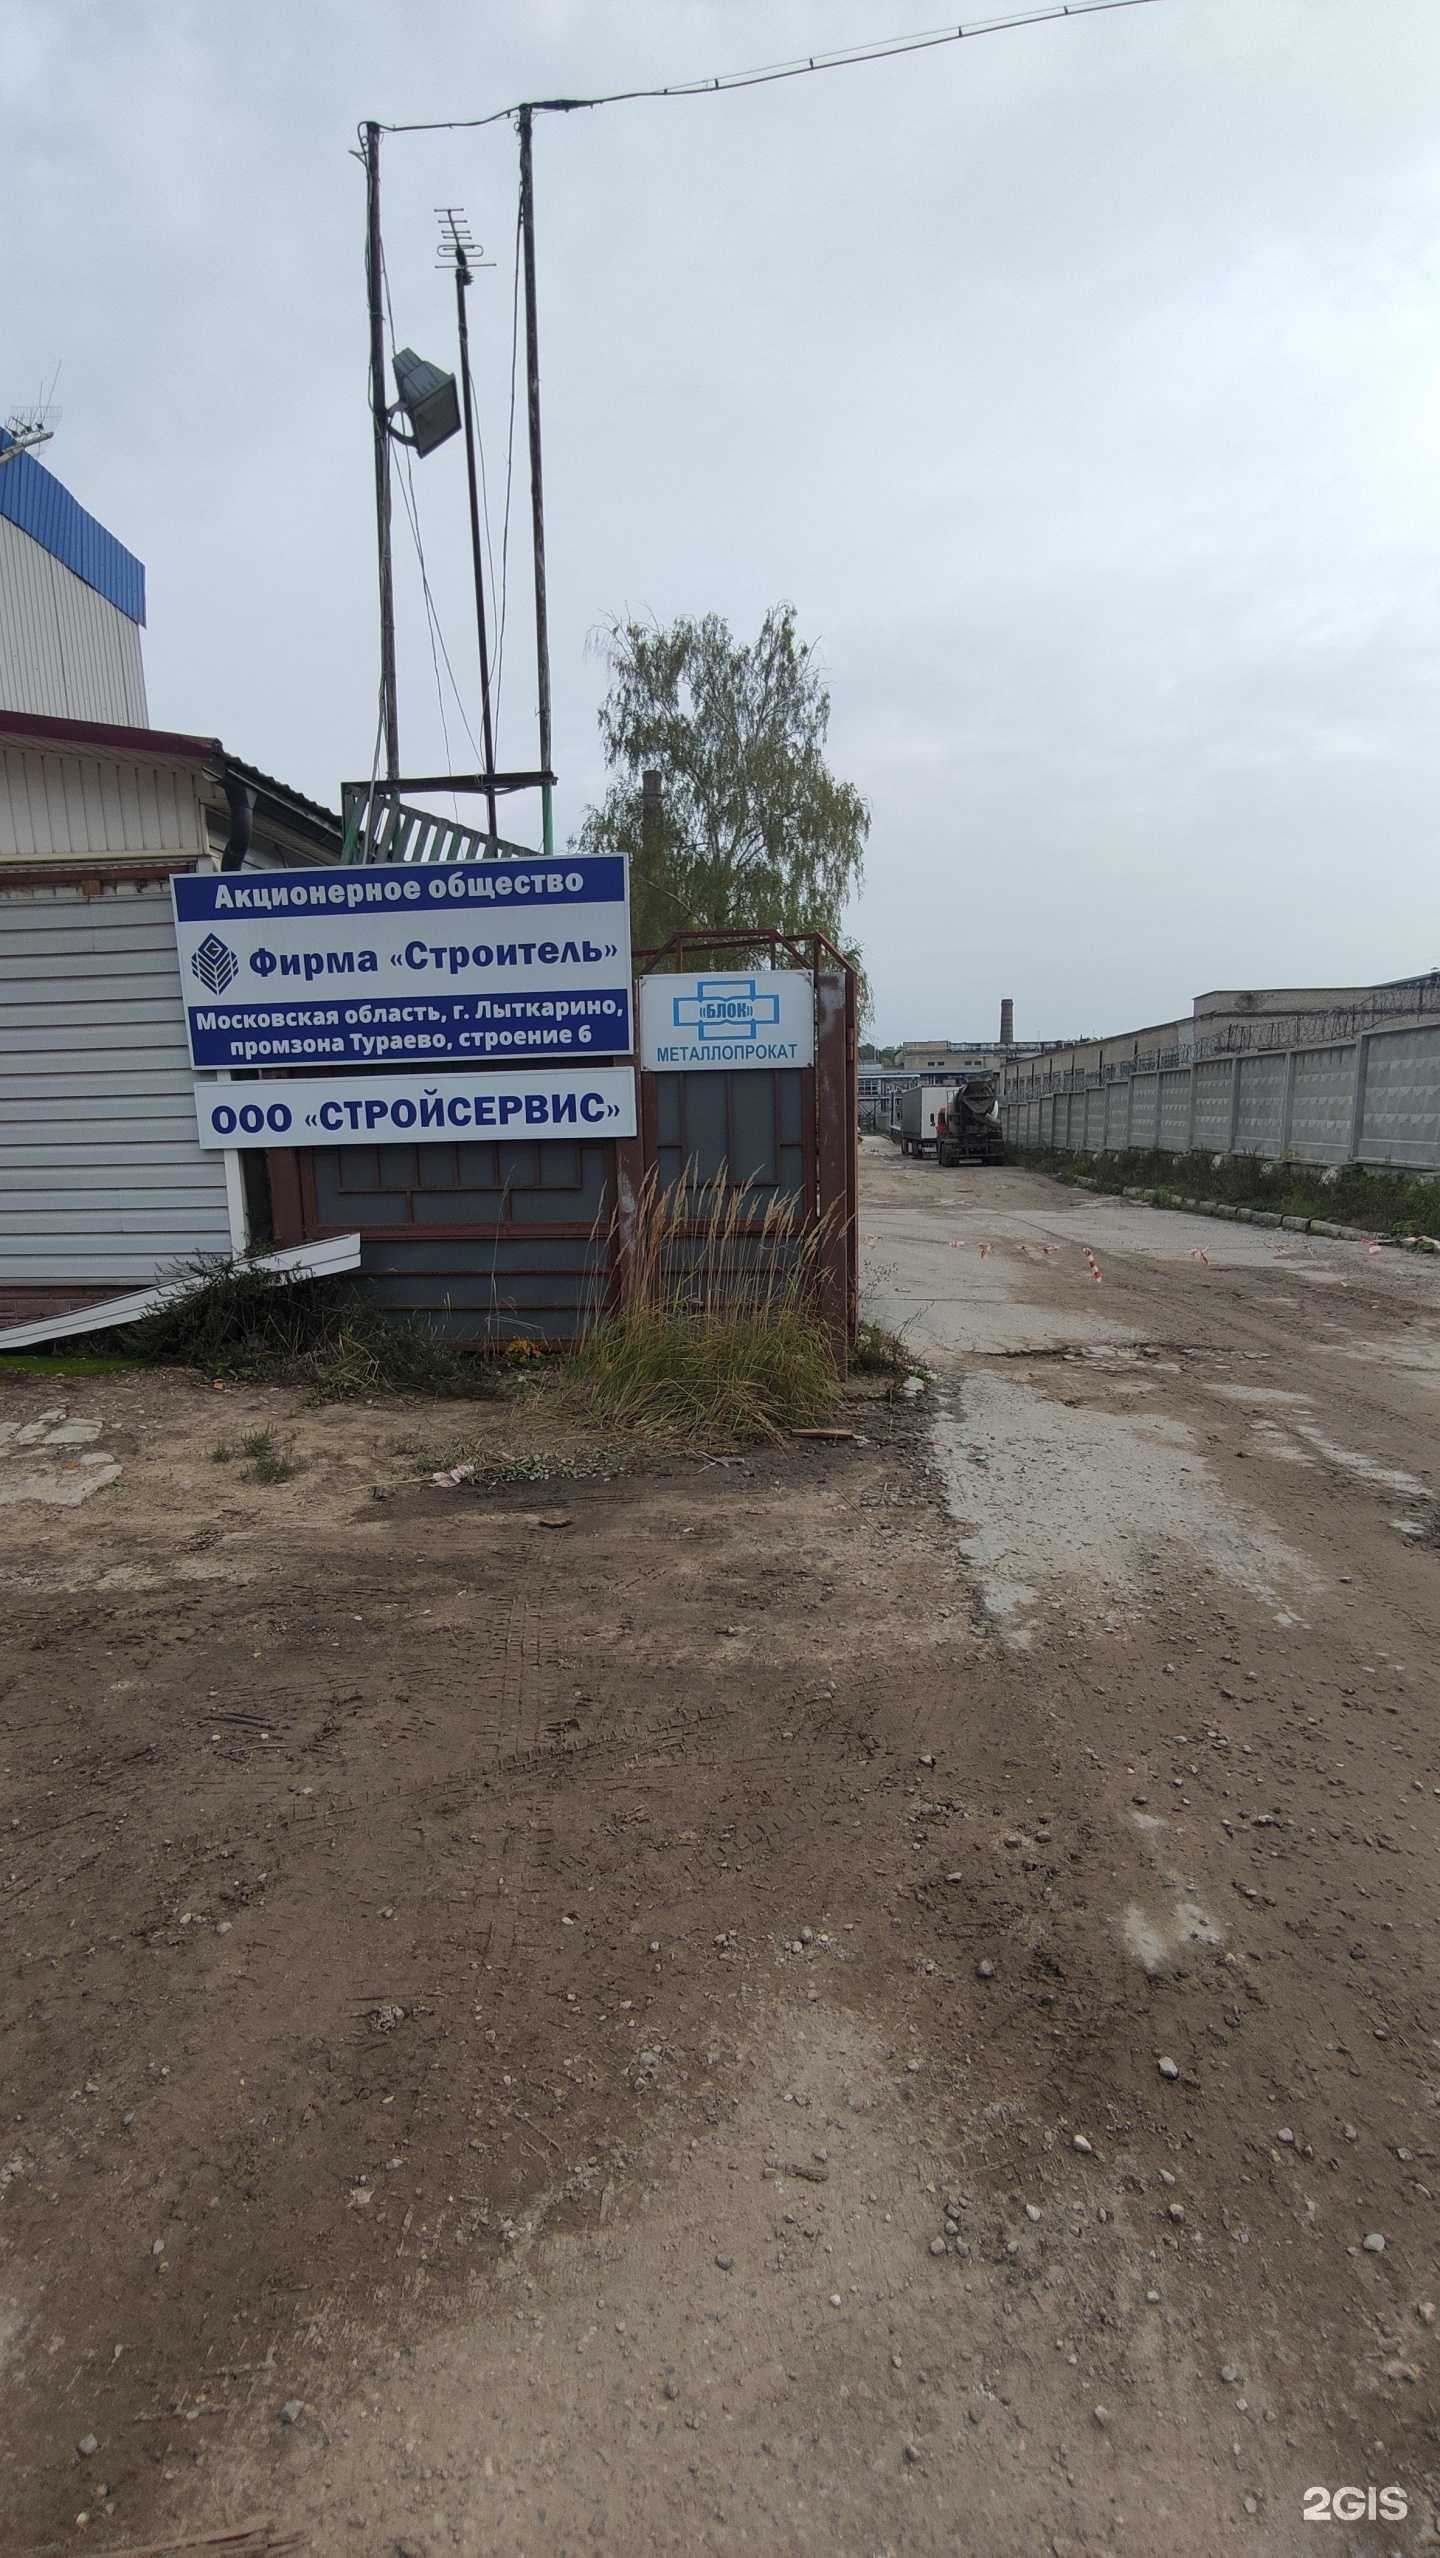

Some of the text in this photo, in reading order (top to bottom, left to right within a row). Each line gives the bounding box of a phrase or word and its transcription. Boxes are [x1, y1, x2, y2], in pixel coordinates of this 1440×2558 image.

[215, 872, 584, 909] Акционерное общество
[249, 940, 618, 981] Фирма «Строитель»
[196, 997, 624, 1031] Московская область, г. Лыткарино,
[230, 1025, 592, 1060] промзона Тураево, строение 6
[657, 1043, 798, 1062] МЕТАЛЛОПРОКАТ
[211, 1088, 620, 1135] ООО «СТРОЙСЕРВИС»
